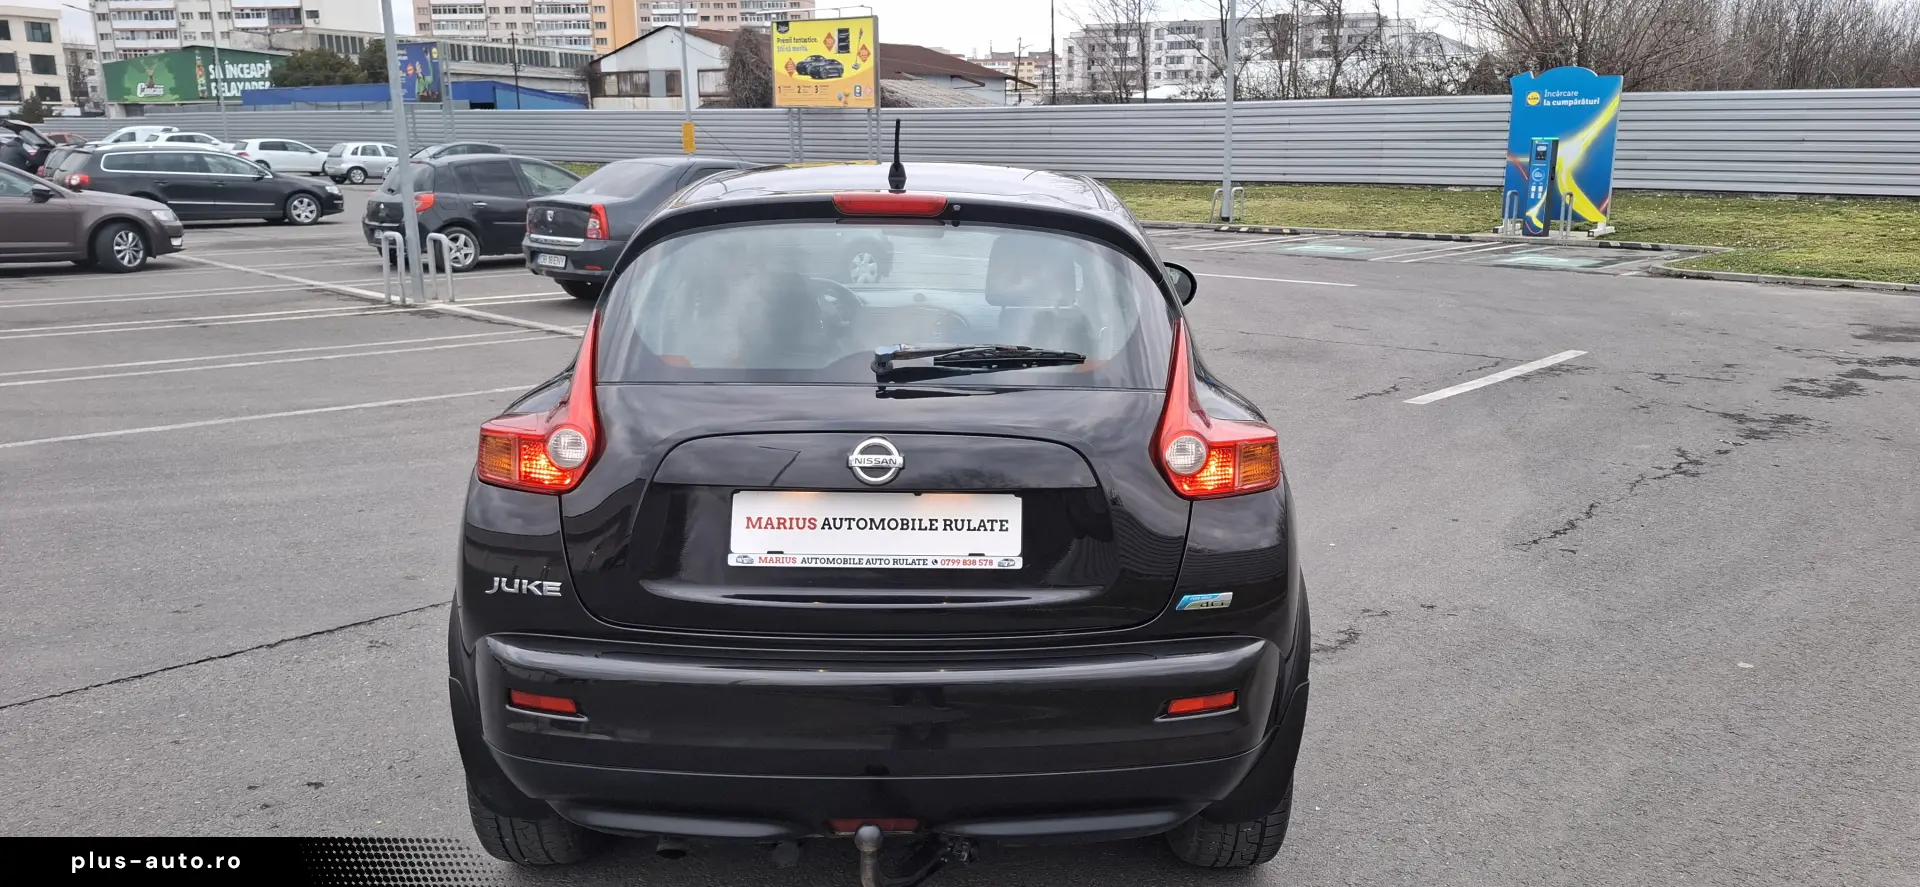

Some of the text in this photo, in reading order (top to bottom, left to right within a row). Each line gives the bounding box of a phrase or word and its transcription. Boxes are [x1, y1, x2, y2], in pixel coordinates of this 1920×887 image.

[797, 85, 801, 93] 2
[814, 85, 819, 93] 3
[1544, 88, 1579, 97] Încărcare
[1543, 97, 1600, 107] la cumpărături
[854, 457, 897, 465] NISSAN
[745, 517, 1009, 532] MARIUS AUTOMOBILE RULATE
[758, 556, 797, 564] MARIUS
[801, 557, 863, 565] AUTOMOBILE
[865, 558, 890, 566] AUTO
[892, 558, 928, 566] RULATE
[485, 577, 562, 596] JUKE
